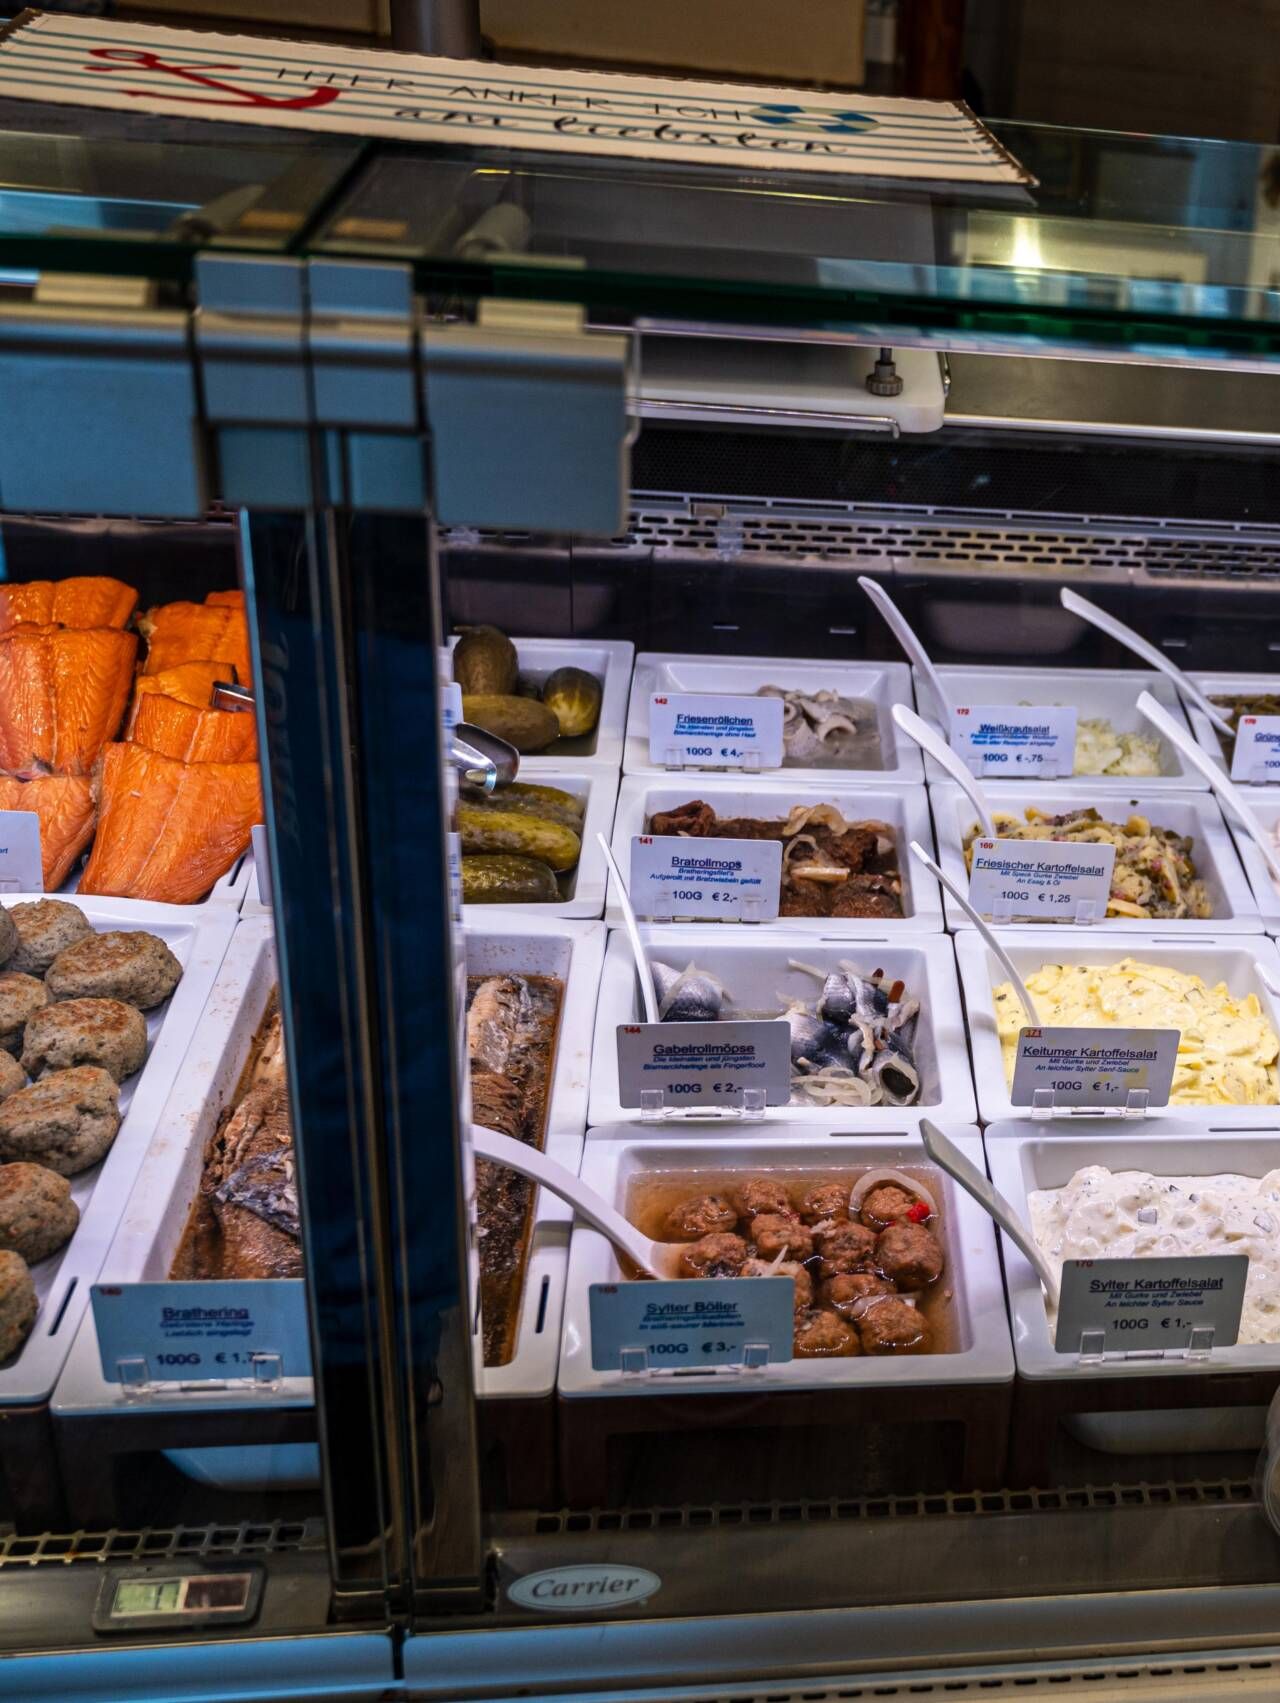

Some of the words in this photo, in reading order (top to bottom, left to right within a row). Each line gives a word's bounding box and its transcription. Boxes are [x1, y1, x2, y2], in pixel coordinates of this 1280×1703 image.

[394, 107, 519, 128] am
[677, 714, 753, 726] Friesenröllchen
[979, 724, 1050, 735] Weißkrautsalat
[686, 747, 712, 756] 100G
[721, 748, 728, 756] €
[730, 748, 744, 758] 4,-
[983, 753, 1008, 762] 100G
[1016, 754, 1023, 763] €
[638, 837, 653, 845] 141
[671, 856, 742, 870] Bratrollmops
[976, 858, 1033, 869] Friesischer
[1037, 862, 1105, 876] Kartoffelsalat
[673, 890, 703, 900] 100G
[712, 892, 720, 901] €
[722, 893, 738, 903] 2,-
[1002, 891, 1029, 900] 100G
[1038, 893, 1046, 902] €
[1049, 894, 1070, 903] 1,25
[653, 1043, 755, 1054] Gabelrollmöpse
[1023, 1046, 1077, 1057] Keitumer
[1081, 1048, 1158, 1059] Kartoffelsalat
[723, 1062, 765, 1070] Fingerfood
[668, 1084, 702, 1093] 100G
[713, 1083, 722, 1092] €
[725, 1083, 743, 1093] 2,-
[1051, 1082, 1082, 1090] 100G
[1093, 1082, 1101, 1090] €
[1104, 1082, 1119, 1092] 1,-
[1075, 1260, 1093, 1268] 170
[1090, 1279, 1131, 1292] Sylter
[1134, 1277, 1223, 1290] Kartoffelsalat
[646, 1302, 690, 1314] Sylter
[693, 1301, 738, 1312] Böller
[1151, 1300, 1175, 1308] Sylter
[162, 1307, 249, 1319] Brathering
[1113, 1319, 1149, 1330] 100G
[1160, 1318, 1170, 1328] €
[1175, 1318, 1192, 1329] 1,-
[649, 1344, 689, 1354] 100G
[701, 1343, 713, 1353] €
[717, 1342, 736, 1353] 3,-
[156, 1353, 201, 1365] 100G
[215, 1353, 226, 1363] €
[531, 1576, 640, 1598] Carrier
